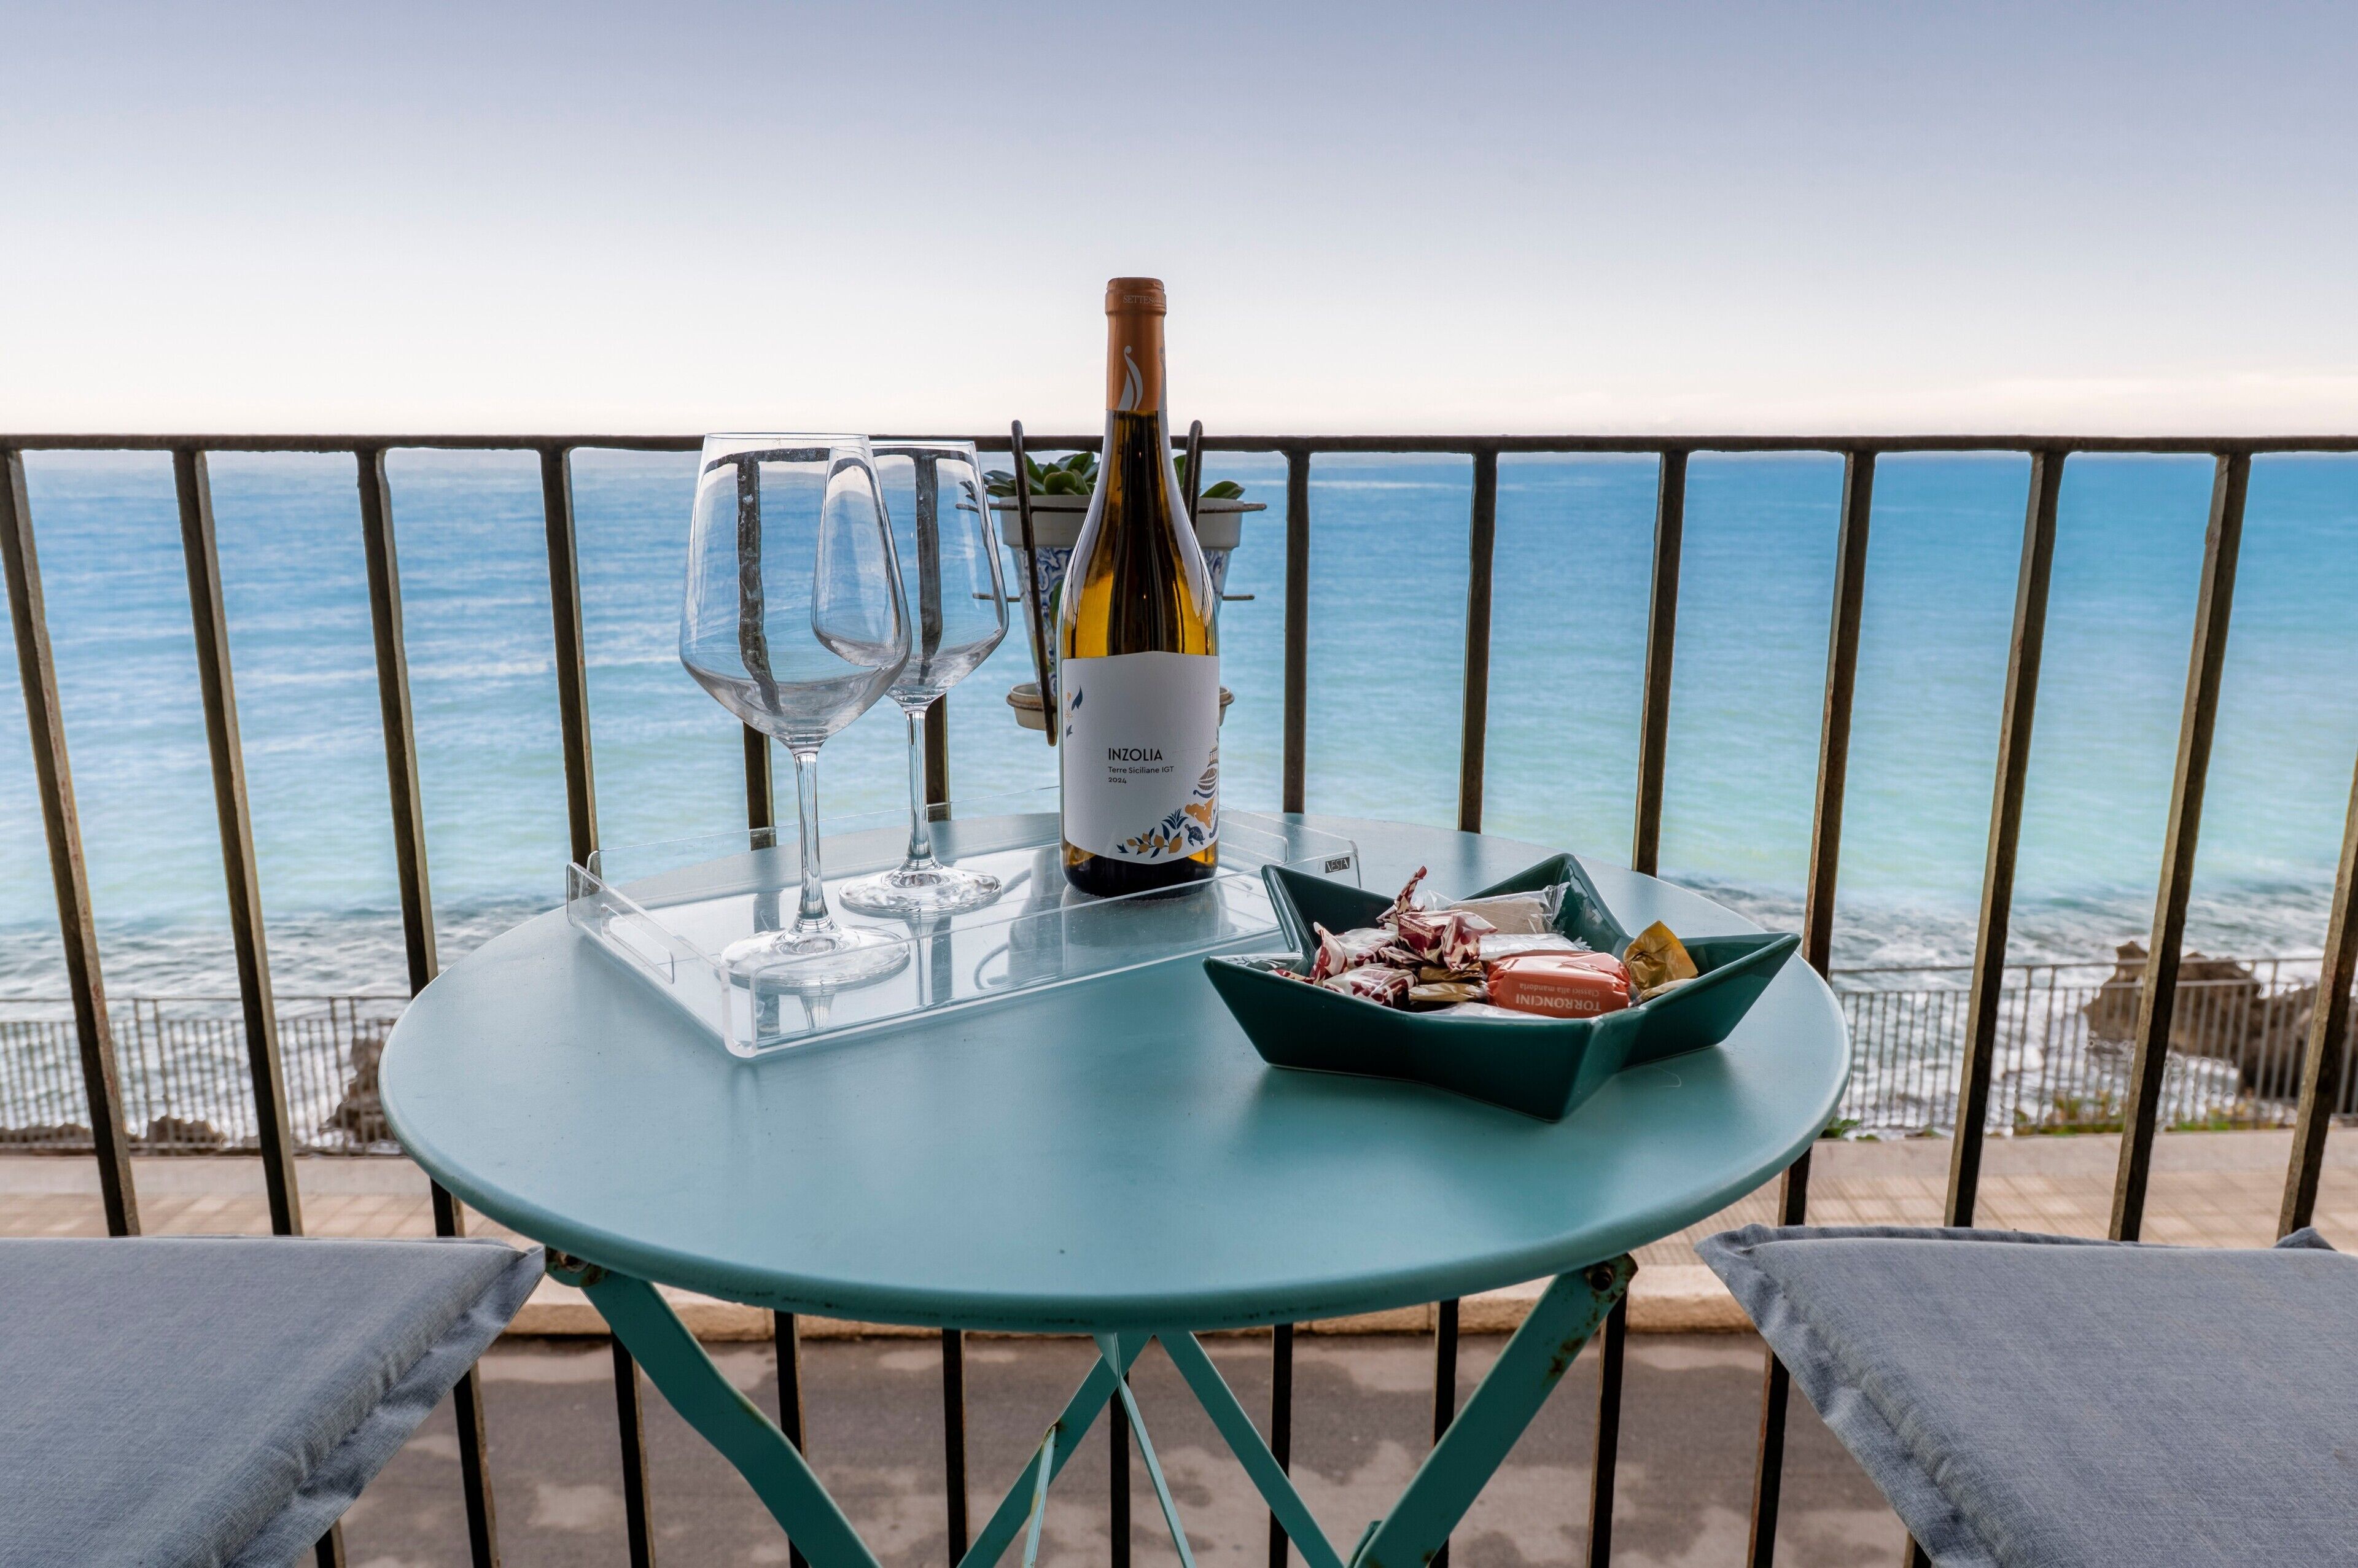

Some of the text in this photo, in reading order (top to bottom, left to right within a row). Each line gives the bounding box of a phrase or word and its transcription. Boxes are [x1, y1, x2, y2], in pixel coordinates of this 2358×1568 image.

[1108, 748, 1163, 761] INZOLIA
[1519, 983, 1555, 992] mandorla
[1572, 987, 1600, 997] Classici
[1516, 993, 1601, 1012] TORRONCINI
